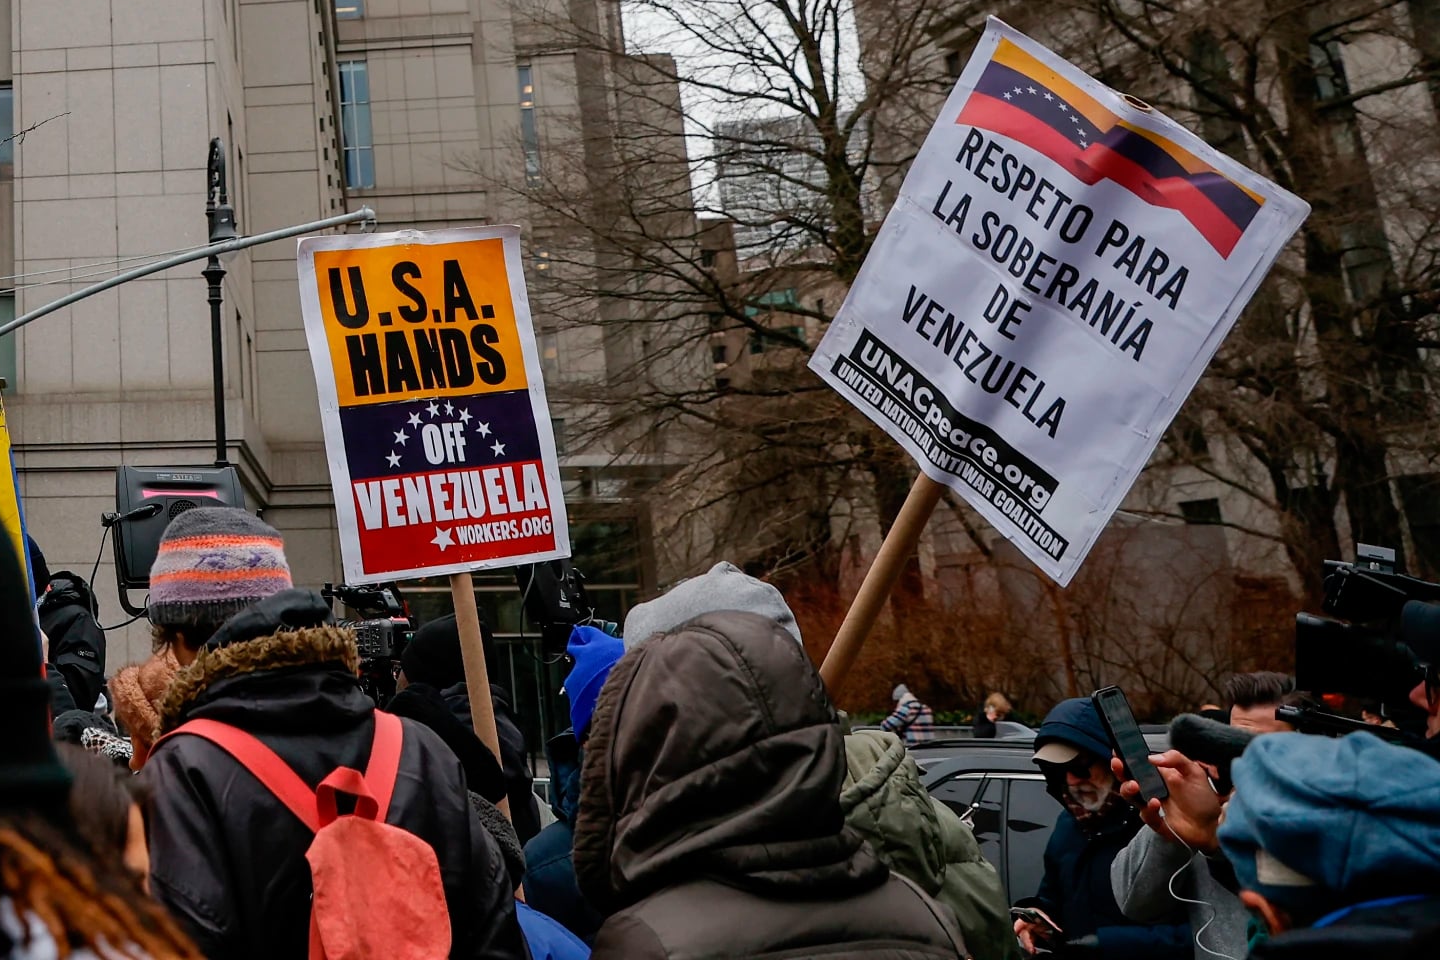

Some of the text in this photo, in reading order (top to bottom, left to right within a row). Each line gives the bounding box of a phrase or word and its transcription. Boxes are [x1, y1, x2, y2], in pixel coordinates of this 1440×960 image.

[955, 127, 1191, 311] RESPETO PARA
[328, 259, 495, 329] U.S.A.
[931, 180, 1155, 362] LA SOBERANÍA
[982, 283, 1032, 341] DE
[345, 323, 507, 397] HANDS
[901, 285, 1067, 439] VENEZUELA
[421, 422, 466, 465] OFF
[837, 361, 1063, 557] UNITED NATIONAL ANTIWAR COALITION
[860, 339, 1052, 510] UNACpeace.org
[354, 463, 548, 530] VENEZUELA
[456, 515, 552, 545] WORKERS.ORG
